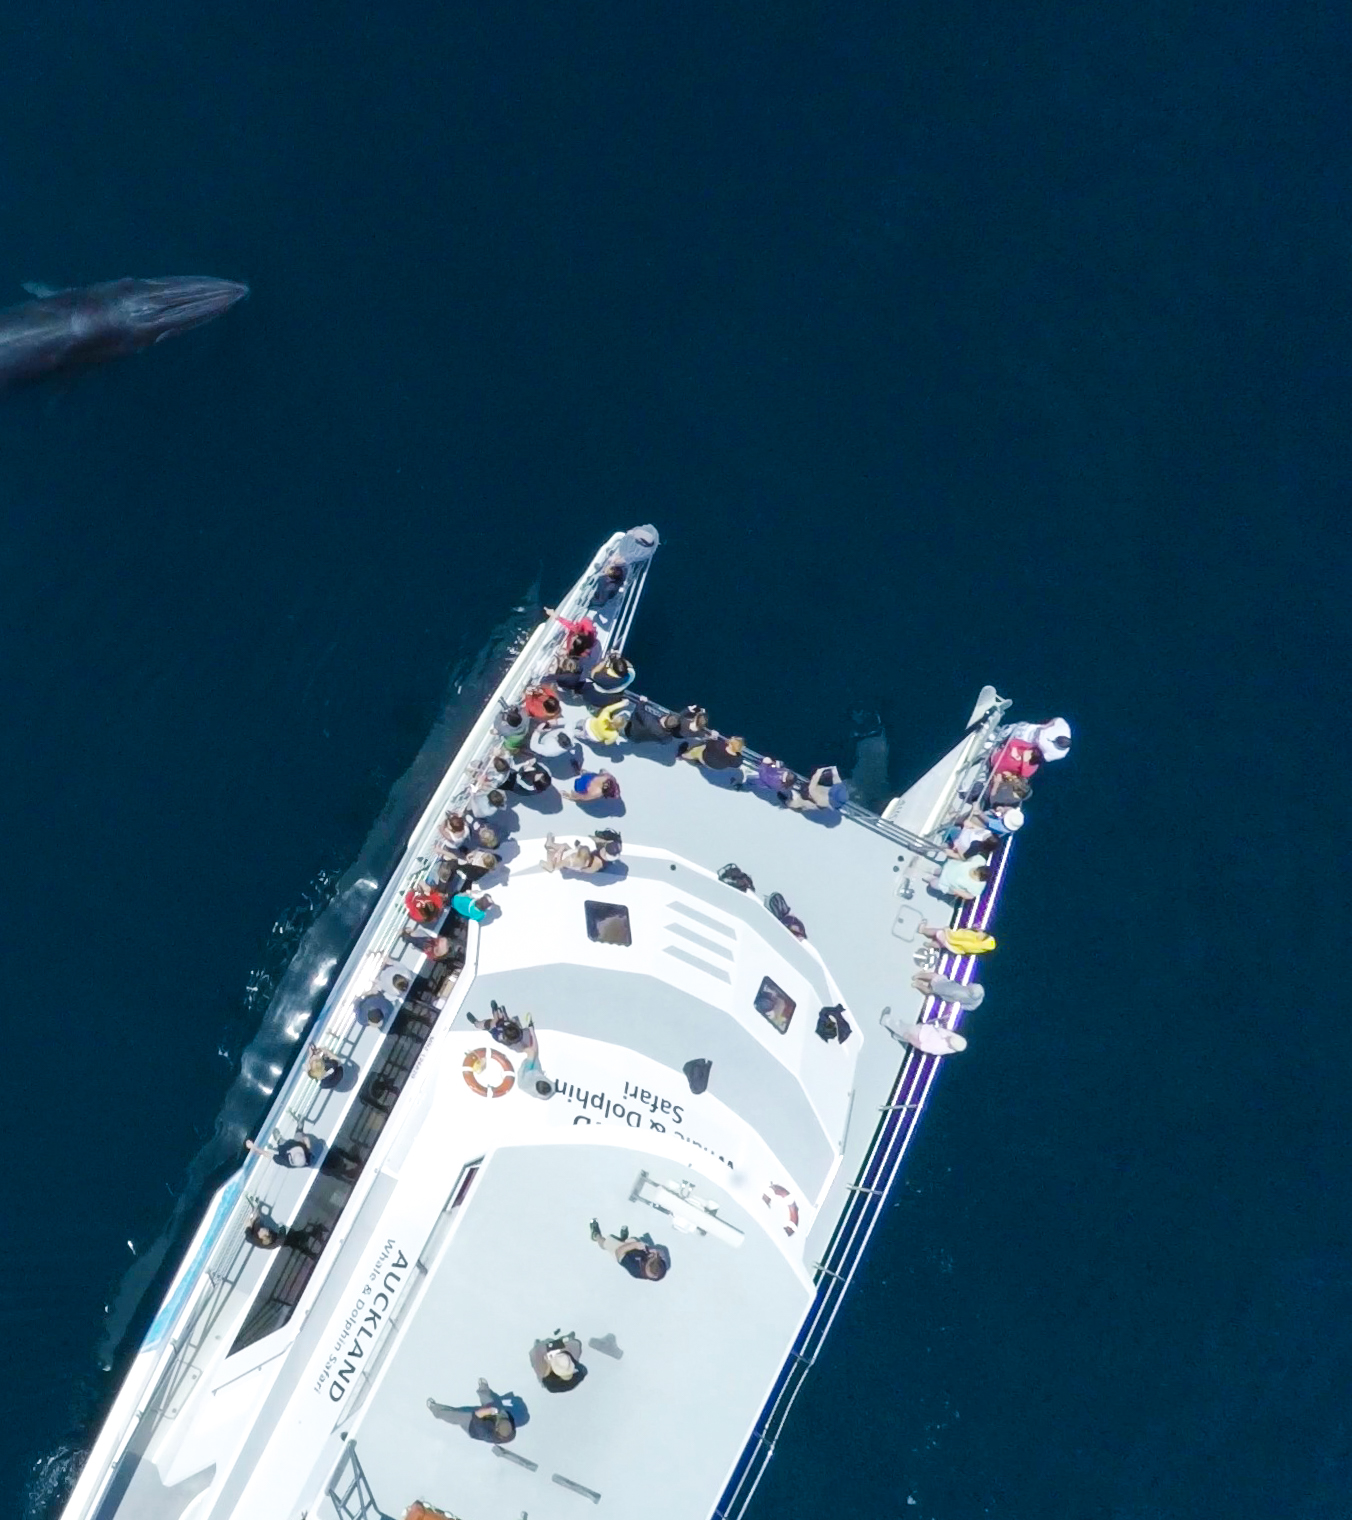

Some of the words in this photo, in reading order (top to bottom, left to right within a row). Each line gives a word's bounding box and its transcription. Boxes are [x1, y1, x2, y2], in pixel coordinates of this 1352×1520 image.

[554, 1079, 642, 1128] Dolphin
[623, 1081, 685, 1124] Safari
[369, 1239, 396, 1282] Whale
[362, 1284, 373, 1296] &
[329, 1249, 409, 1402] AUCKLAND
[334, 1298, 365, 1352] Dolphin
[313, 1353, 338, 1394] Safari
